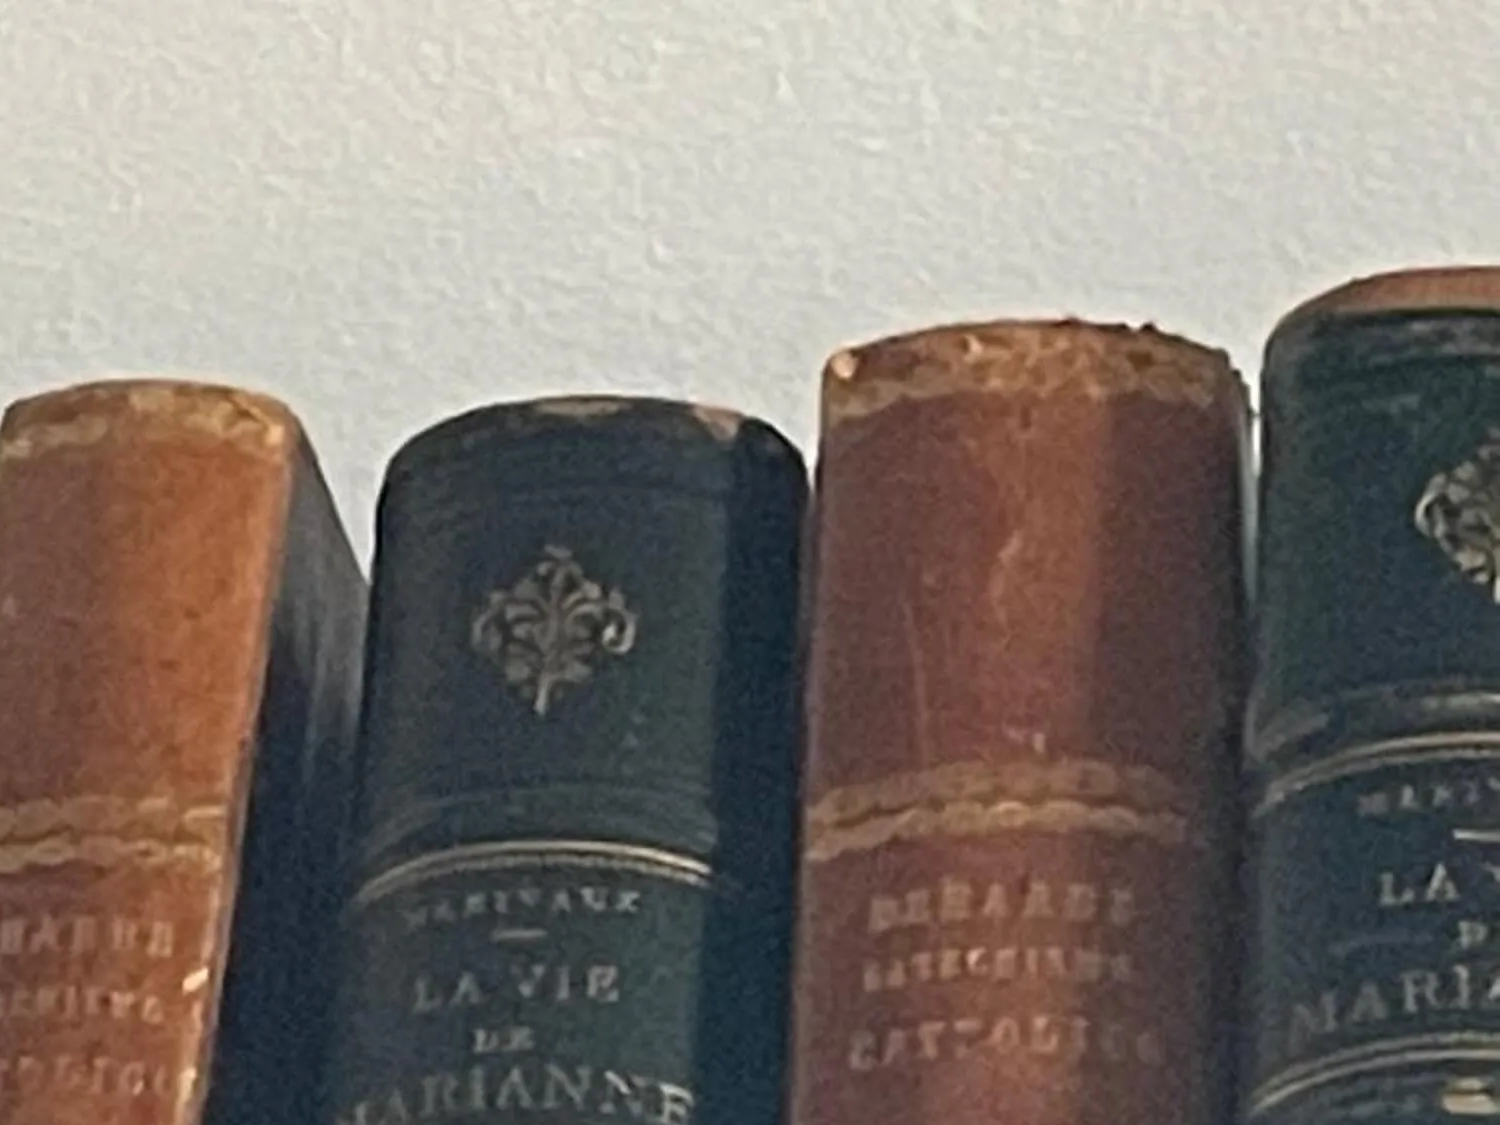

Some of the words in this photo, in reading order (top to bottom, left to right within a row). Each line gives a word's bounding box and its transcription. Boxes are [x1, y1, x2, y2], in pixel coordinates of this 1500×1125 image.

[1380, 862, 1460, 906] LA
[412, 970, 490, 1014] LA
[510, 963, 621, 1003] VIE
